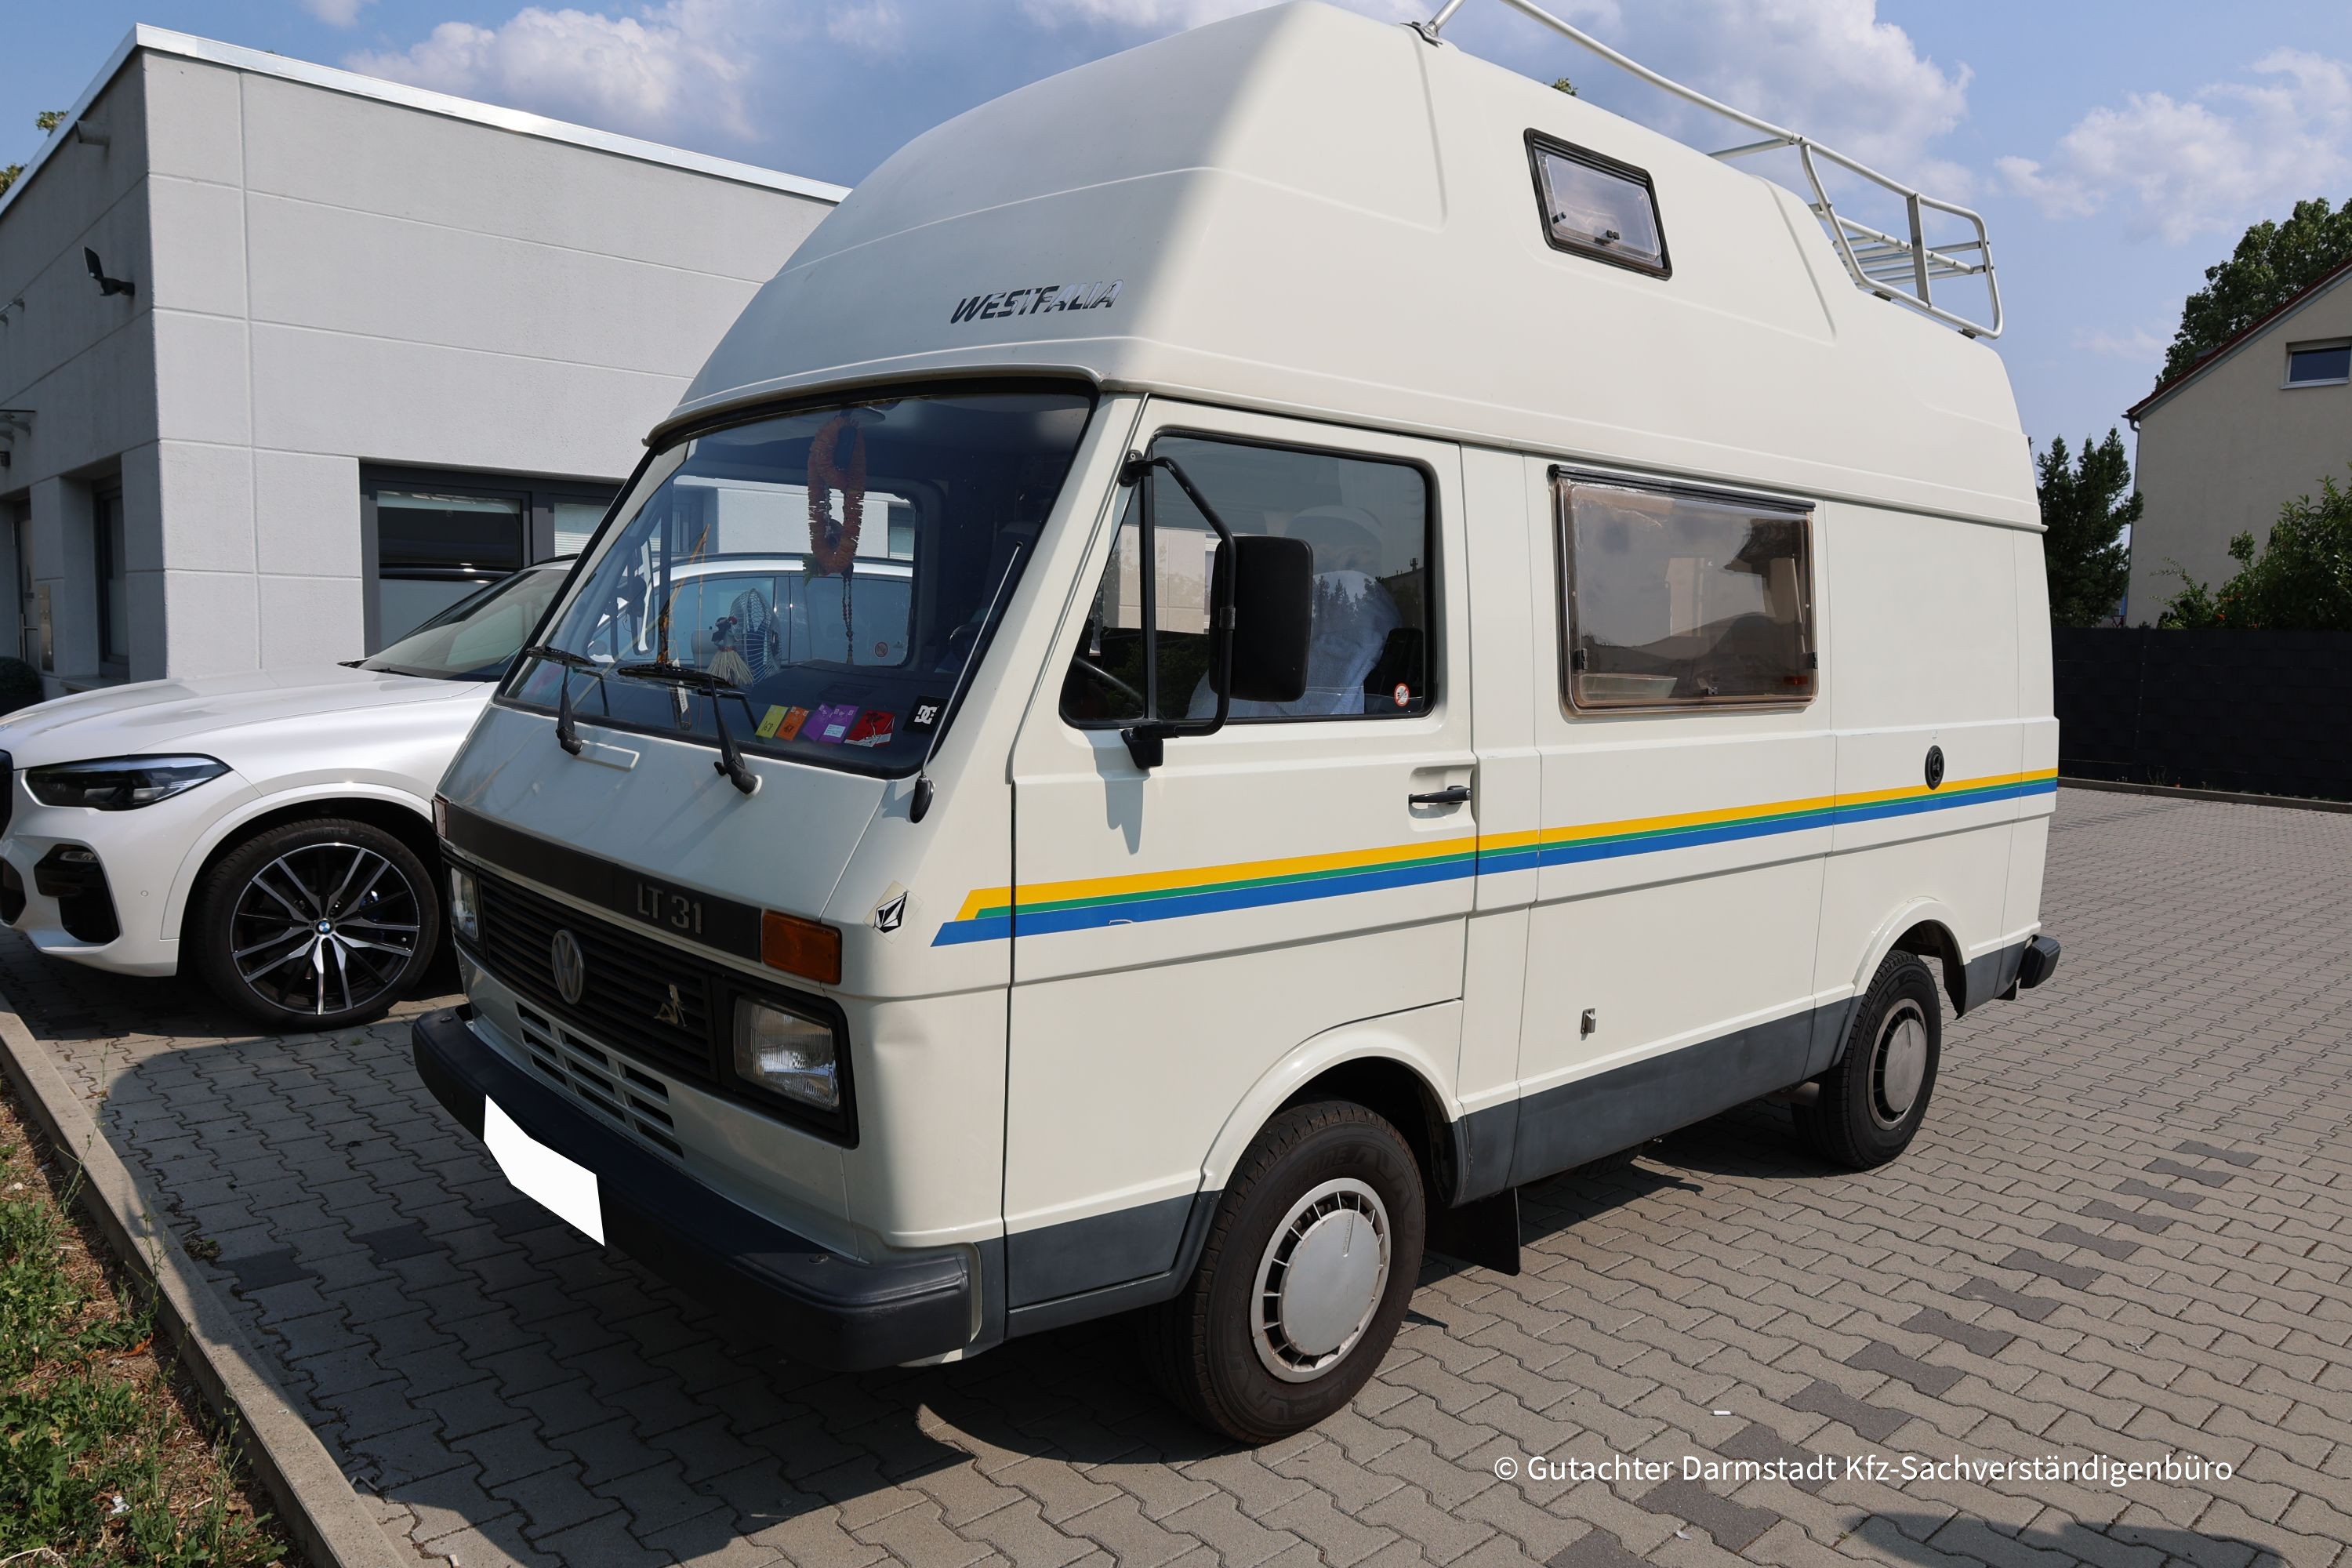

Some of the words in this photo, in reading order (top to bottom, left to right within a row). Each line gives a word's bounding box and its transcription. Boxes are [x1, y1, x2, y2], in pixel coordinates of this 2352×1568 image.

[950, 279, 1124, 324] WESTFALIA
[637, 884, 664, 919] LT
[671, 895, 702, 935] 31
[552, 930, 584, 1004] VW
